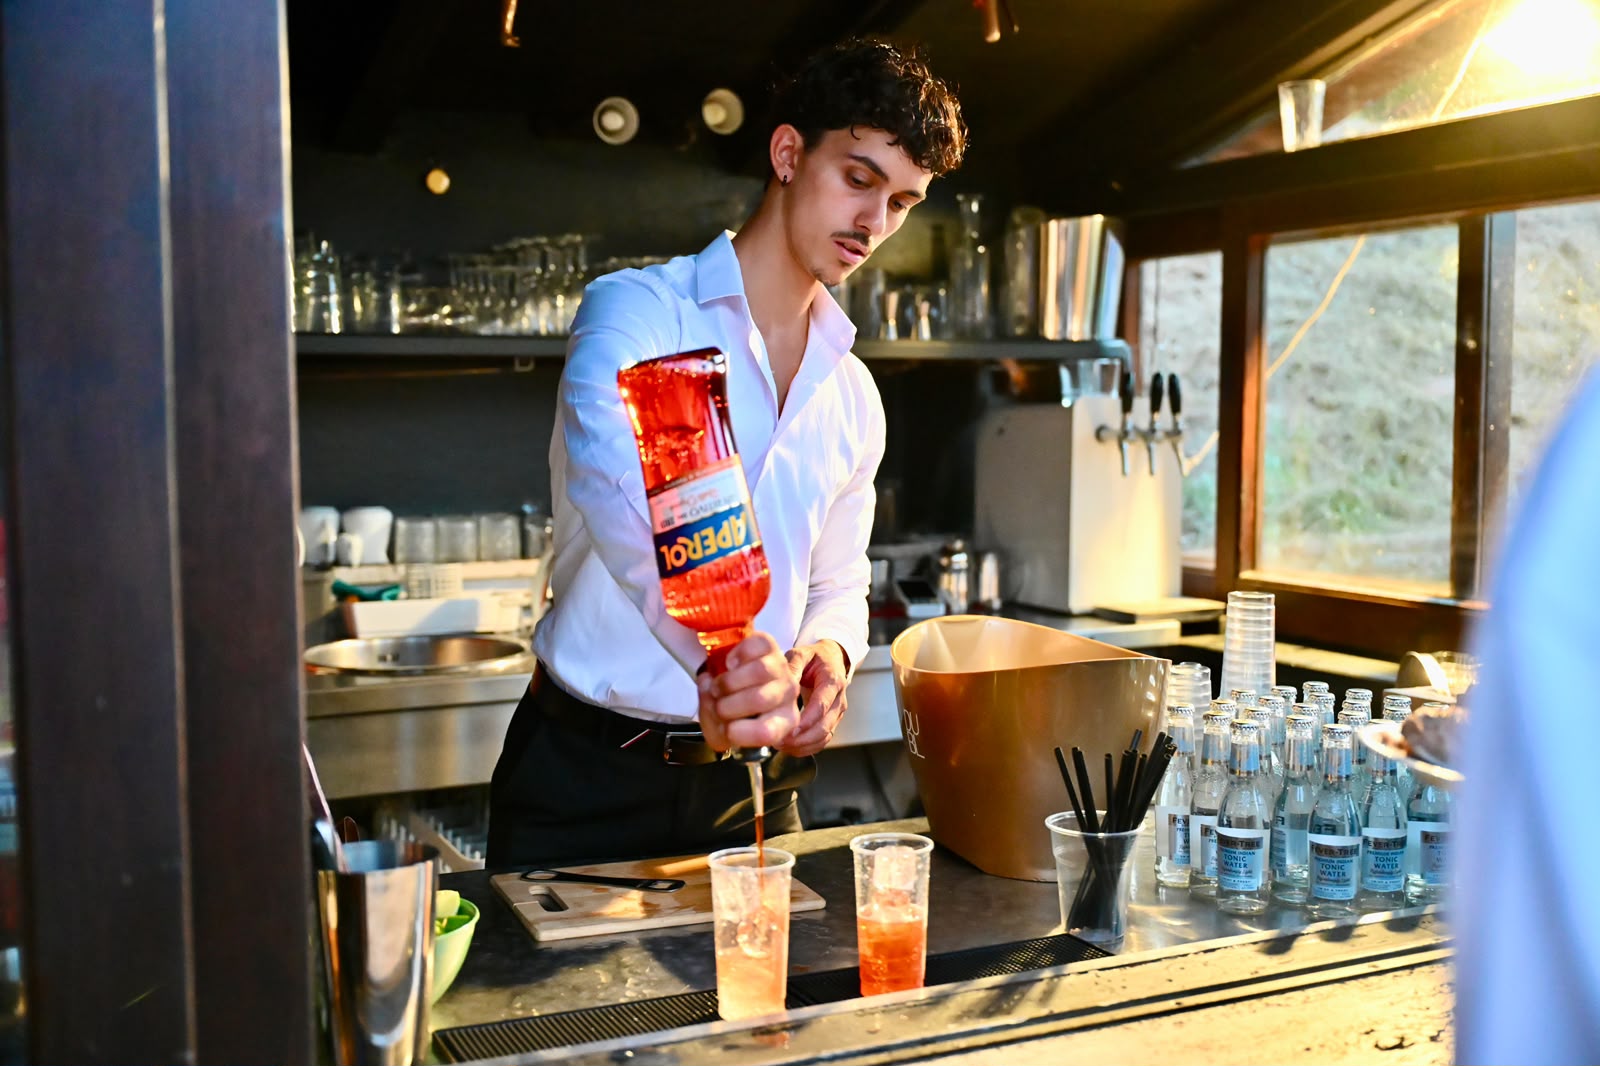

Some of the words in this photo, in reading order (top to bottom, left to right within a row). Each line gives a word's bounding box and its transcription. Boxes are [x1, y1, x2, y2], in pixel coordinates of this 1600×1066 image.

[660, 512, 747, 570] APEROL
[1223, 853, 1247, 862] TONIC
[1223, 860, 1248, 869] WATER
[1320, 869, 1346, 878] WATER
